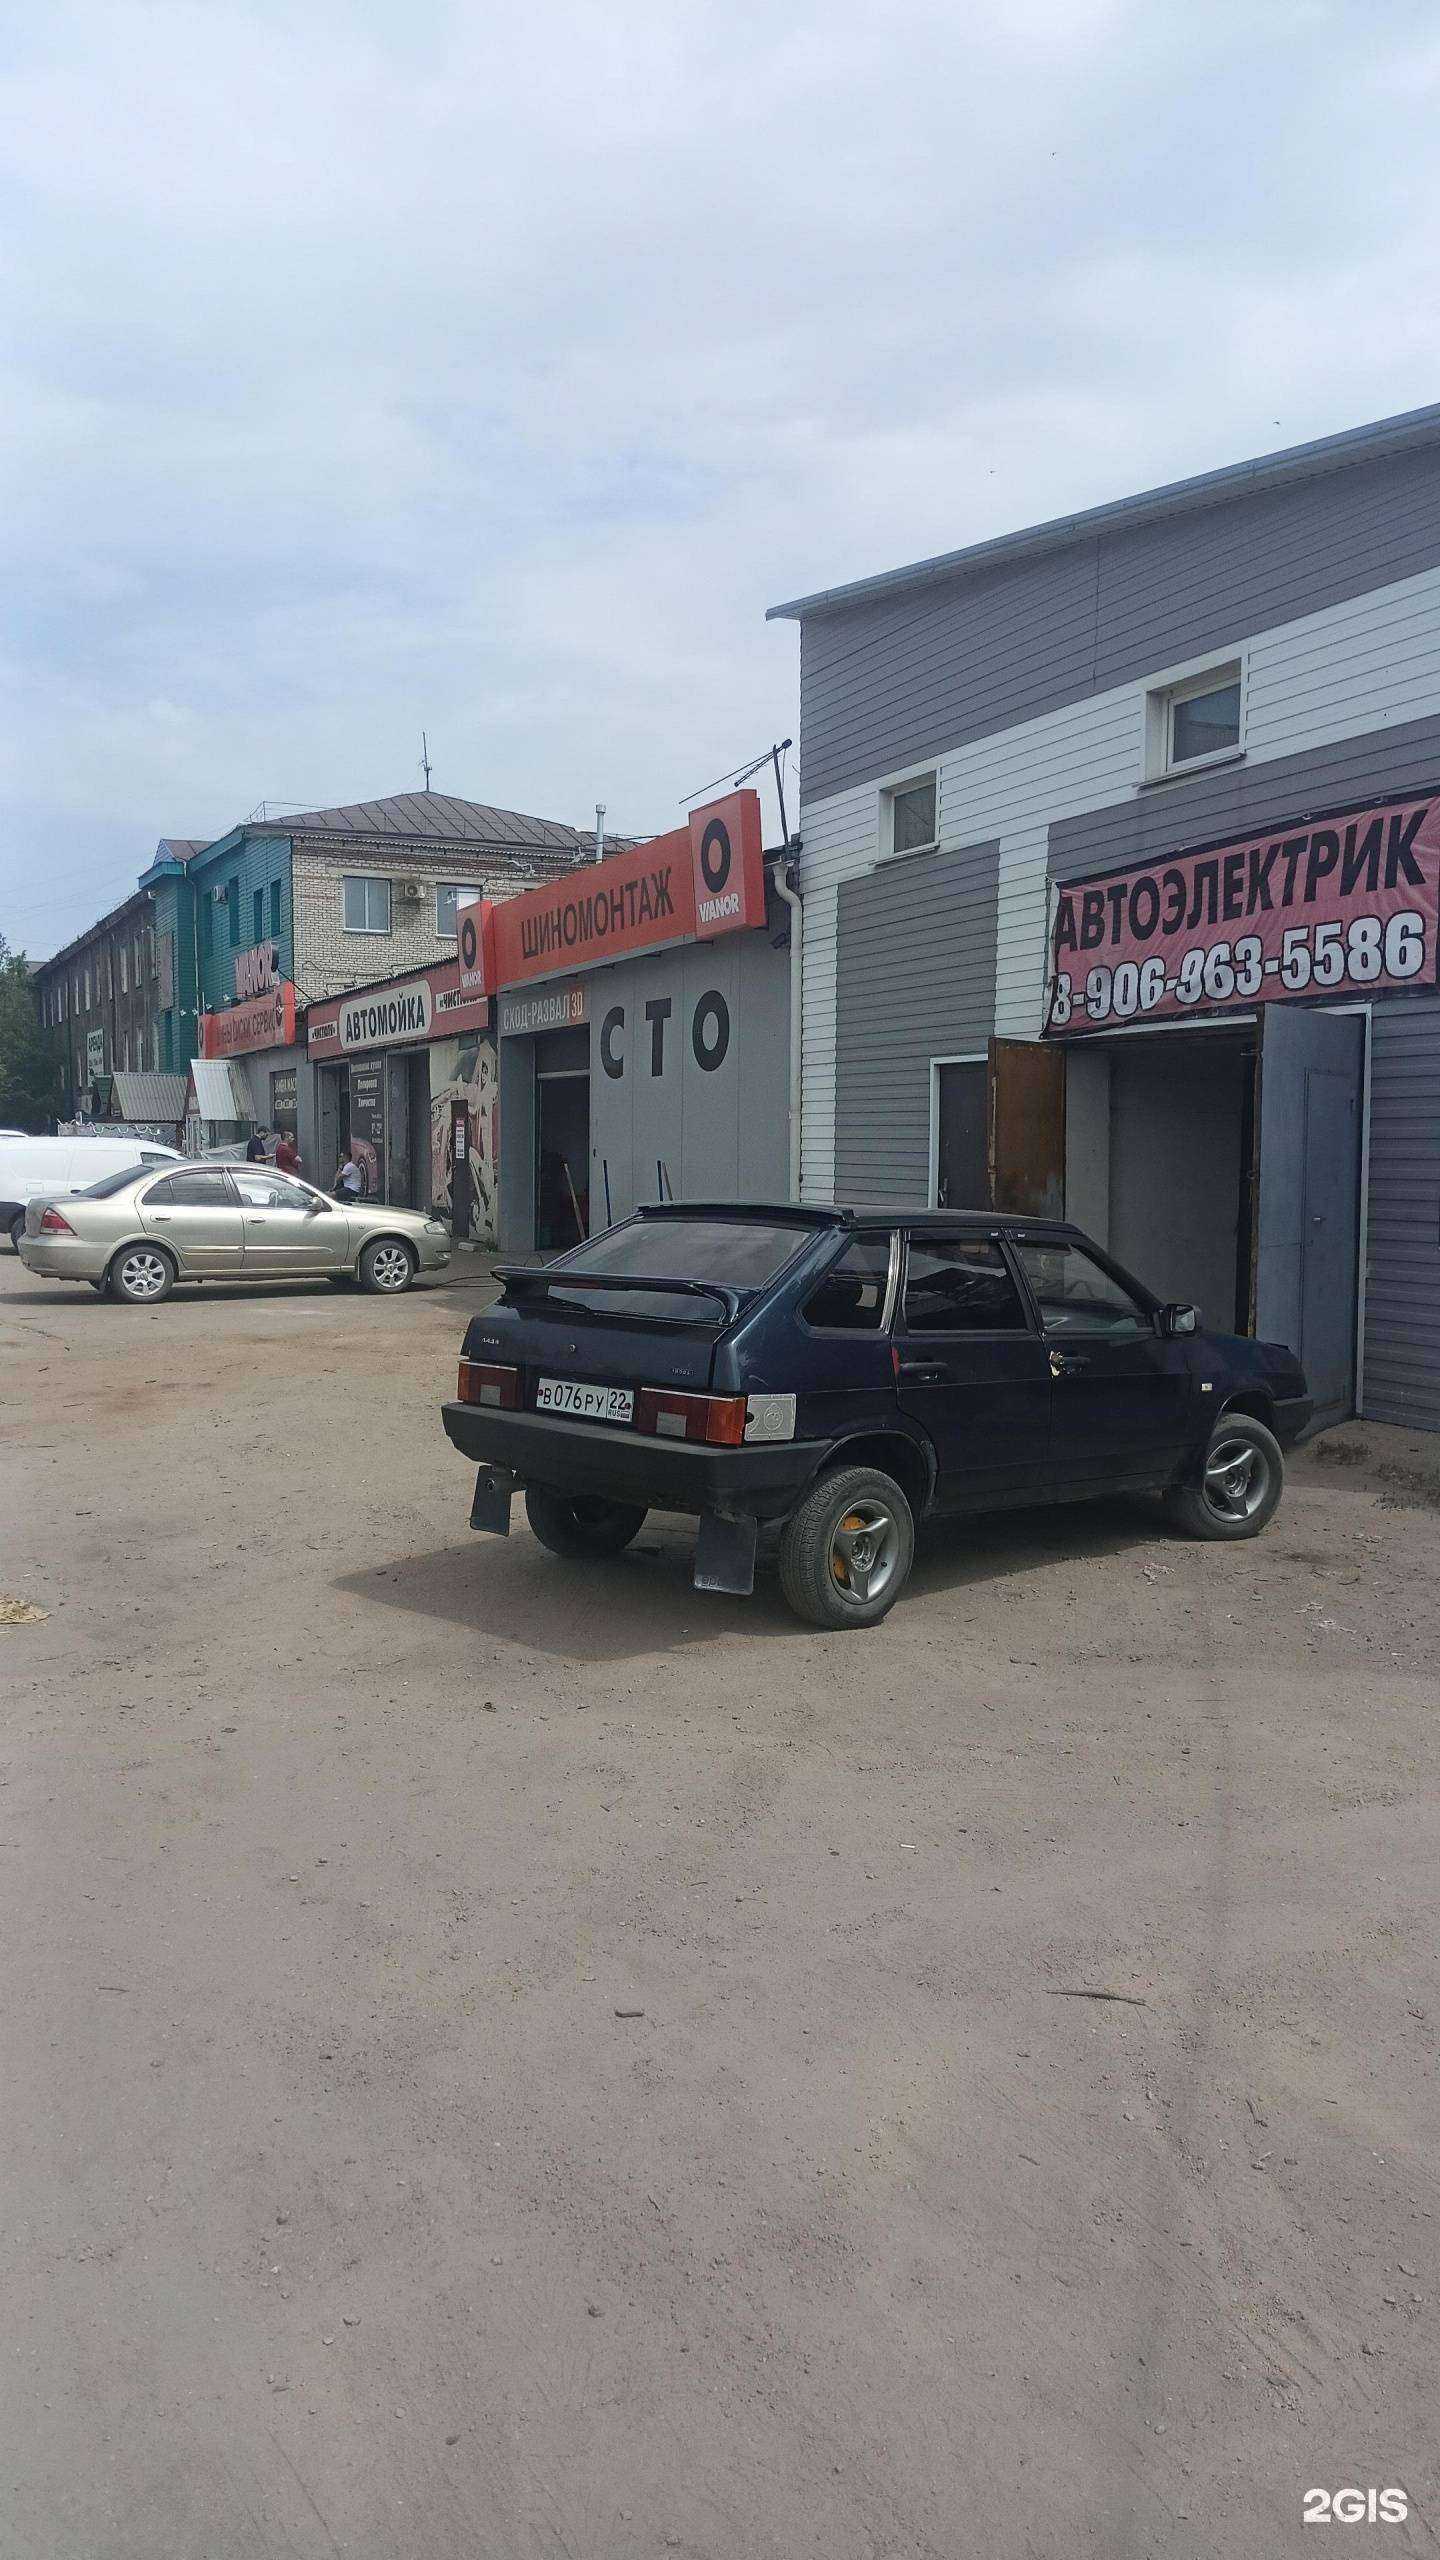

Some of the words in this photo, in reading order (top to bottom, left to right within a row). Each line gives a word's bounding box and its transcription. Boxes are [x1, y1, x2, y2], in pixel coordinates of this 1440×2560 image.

[1054, 809, 1428, 953] АВТОЭЛЕКТРИК
[520, 867, 675, 960] ШИНОМОНТАЖ
[698, 892, 740, 923] VIANOR
[461, 970, 482, 988] VIANOR
[1051, 911, 1425, 1025] 8-906-963-5586
[346, 993, 425, 1043] АВТОМОЙКА
[503, 994, 570, 1031] СХОД-РАЗВАЛ
[571, 991, 583, 1018] 3D
[601, 990, 730, 1080] СТО
[543, 1384, 604, 1412] В076РУ
[609, 1391, 627, 1410] 22
[607, 1409, 621, 1418] RUS
